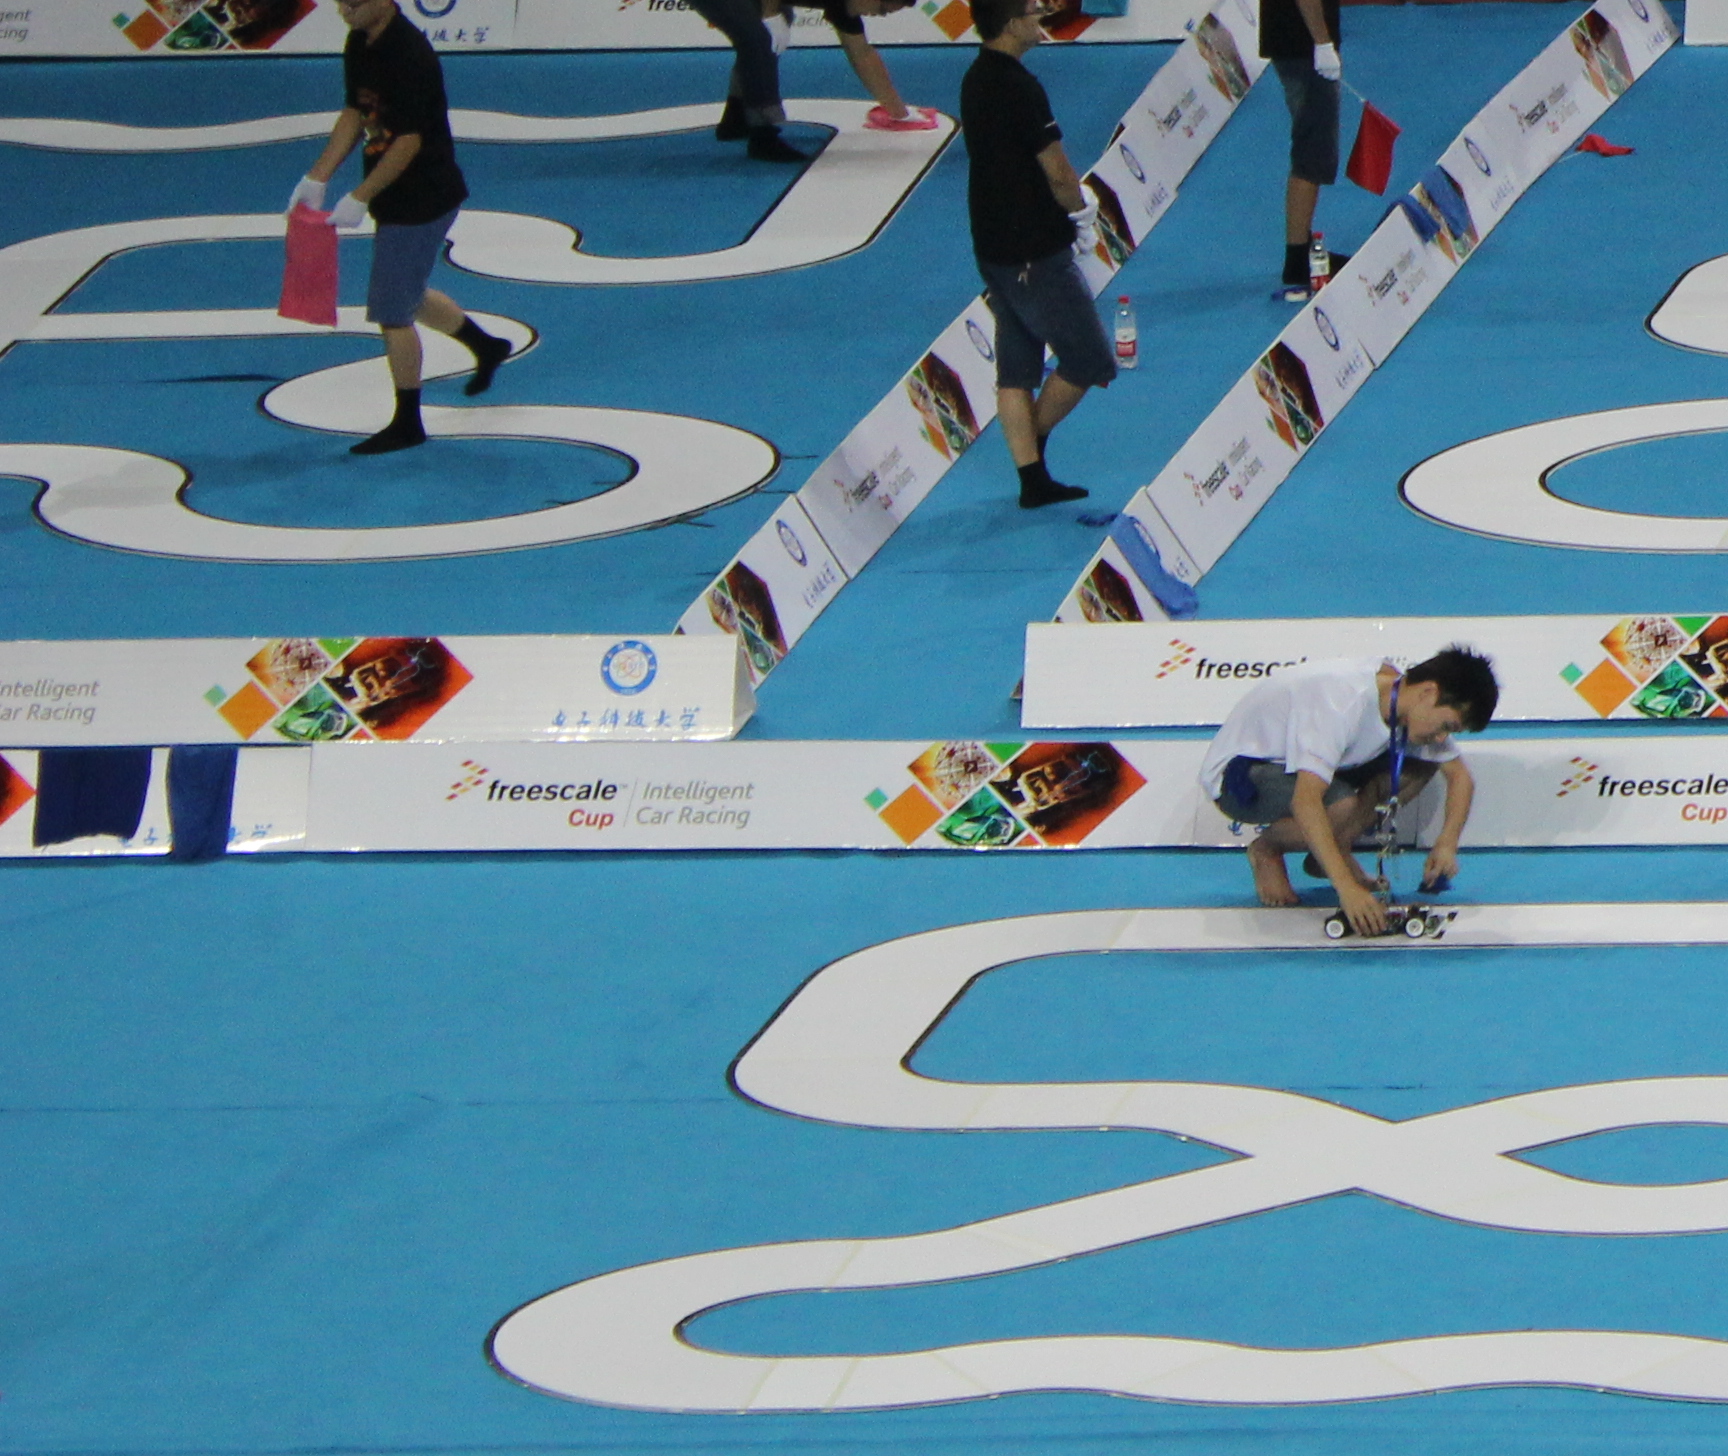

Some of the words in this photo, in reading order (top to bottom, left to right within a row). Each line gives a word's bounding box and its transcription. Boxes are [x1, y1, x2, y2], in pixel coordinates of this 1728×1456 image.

[26, 701, 96, 726] Racing
[488, 776, 618, 803] freescale
[643, 779, 755, 806] Intelligent
[568, 807, 615, 832] Cup
[635, 806, 675, 825] Car
[679, 804, 752, 829] Racing
[1681, 800, 1727, 826] Cup
